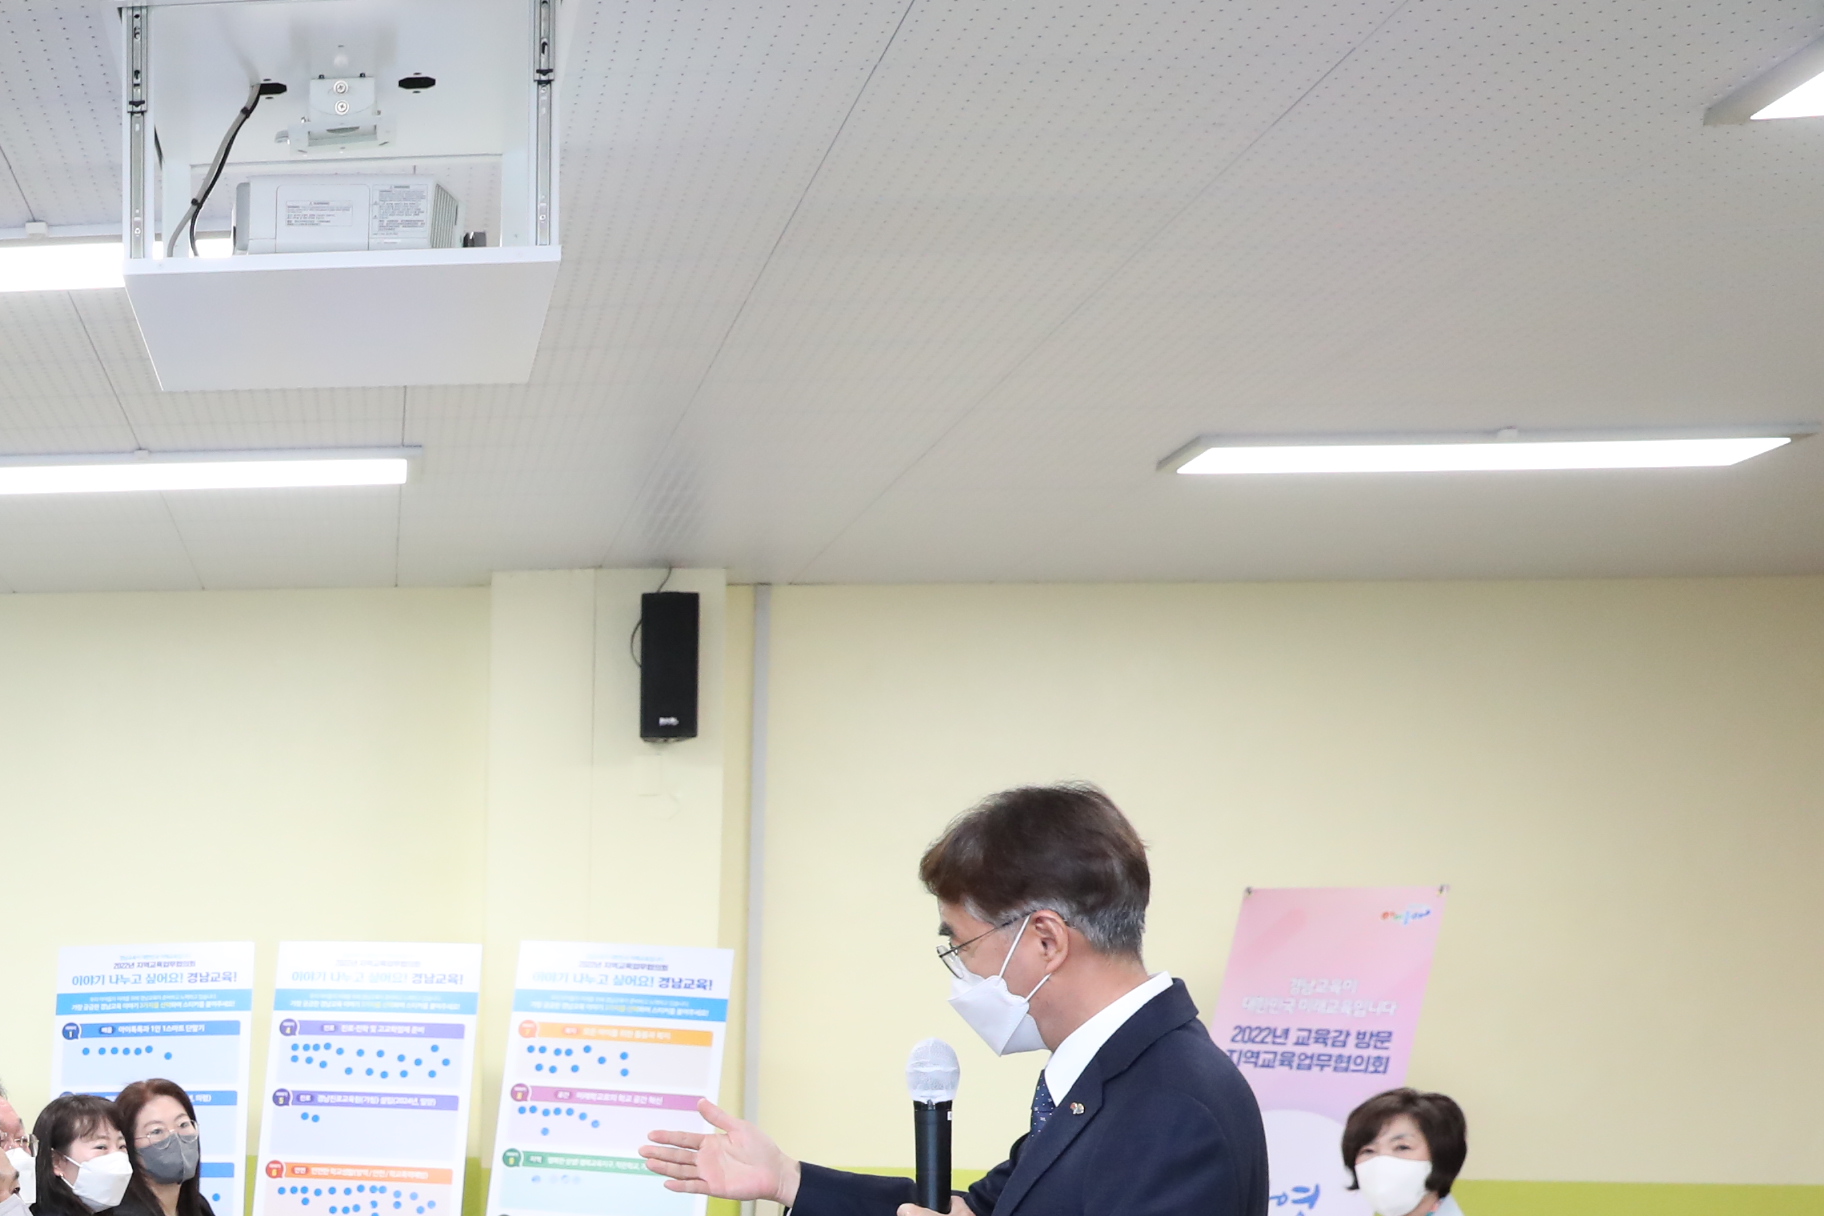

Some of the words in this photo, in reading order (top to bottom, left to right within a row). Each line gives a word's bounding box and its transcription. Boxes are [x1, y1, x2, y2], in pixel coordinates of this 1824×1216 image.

[72, 975, 105, 986] 이야기
[109, 973, 141, 985] 나누고
[187, 971, 237, 983] 경남교육!
[292, 970, 326, 982] 이야기
[330, 971, 365, 983] 나누고
[412, 973, 463, 985] 경남교육!
[573, 973, 609, 985] 나누고
[658, 977, 713, 991] 경남교육!
[1290, 978, 1359, 995] 경남교육이
[1298, 998, 1397, 1018] 미래교육입니다
[1231, 1025, 1290, 1045] 2022년
[1293, 1027, 1351, 1048] 교육감
[1355, 1030, 1392, 1050] 방문
[1226, 1049, 1390, 1074] 지역교육업무협의회
